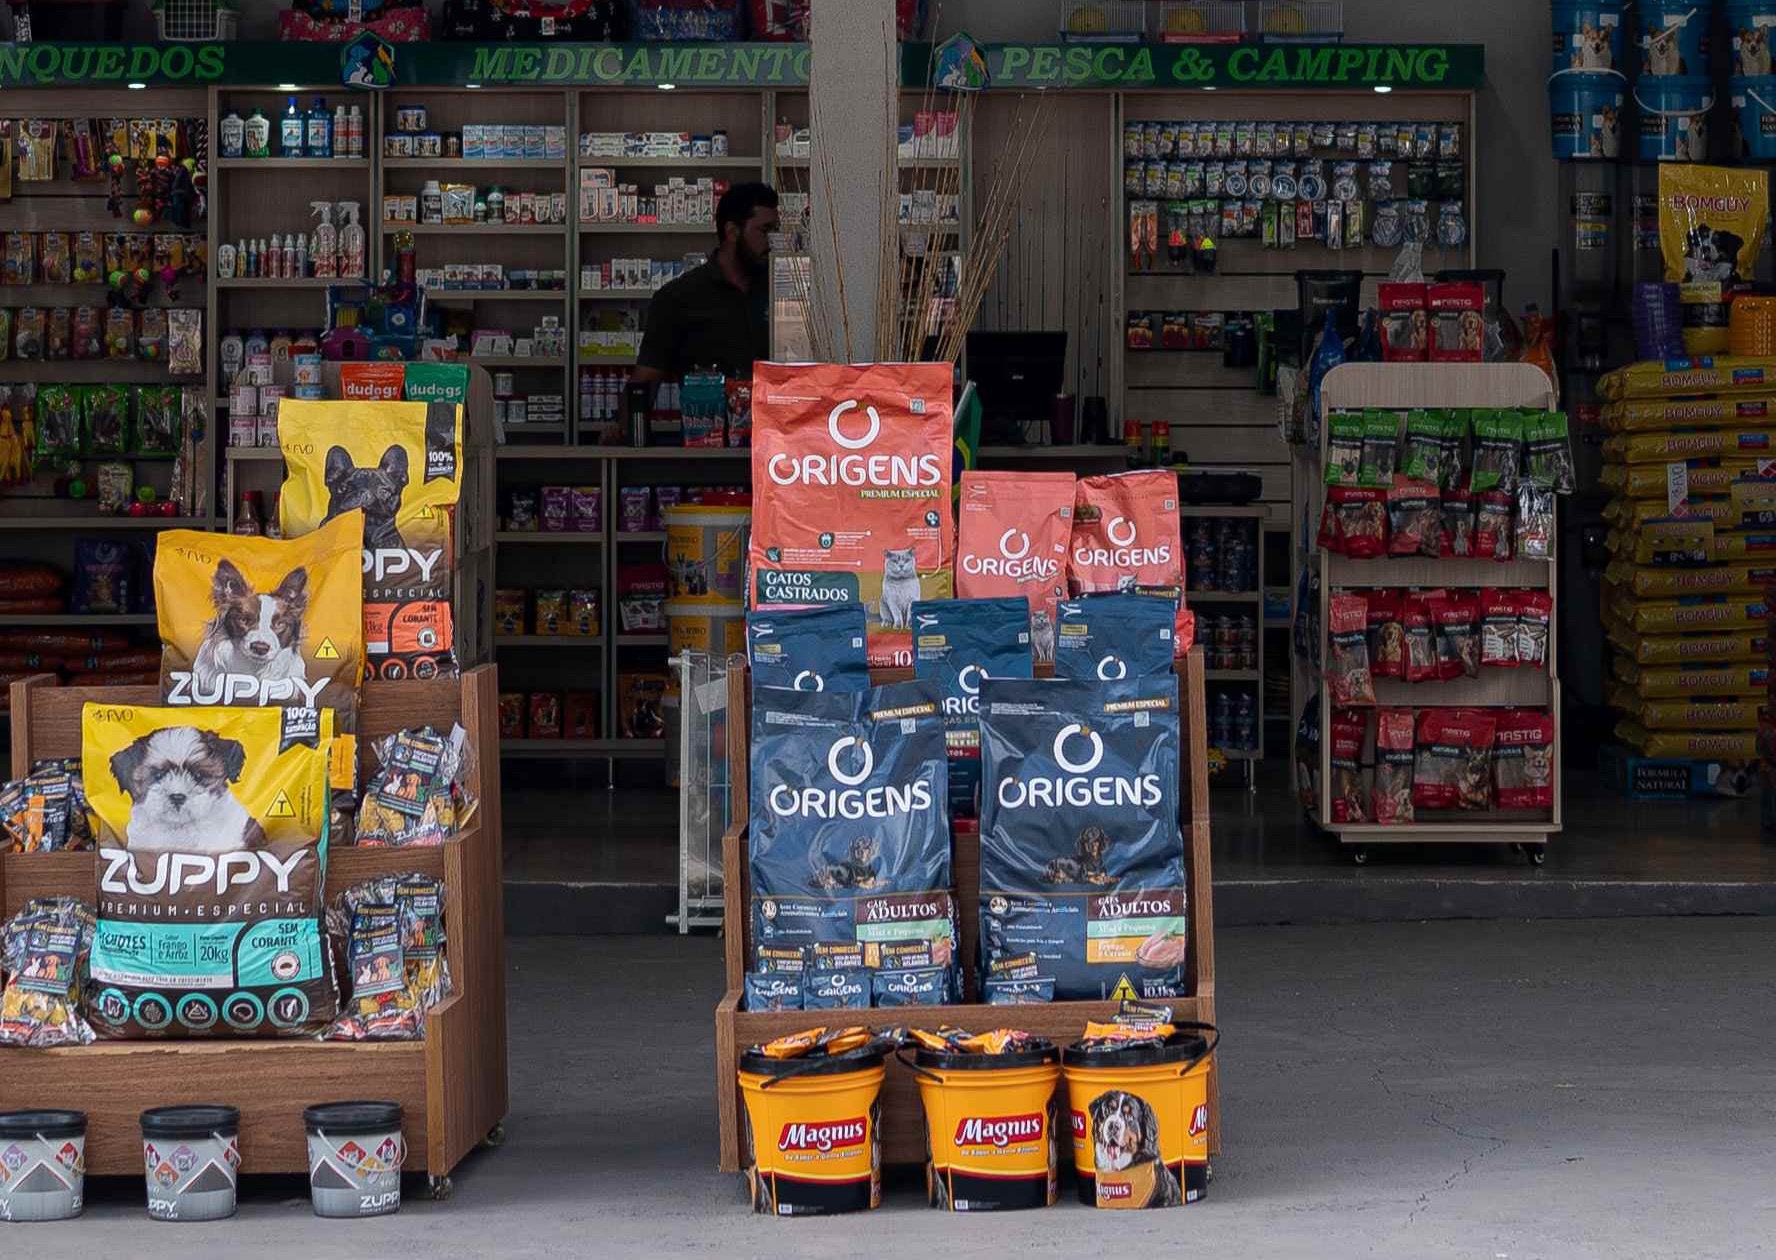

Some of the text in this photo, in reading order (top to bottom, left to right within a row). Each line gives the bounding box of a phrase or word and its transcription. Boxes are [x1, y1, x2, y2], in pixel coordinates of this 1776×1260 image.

[468, 46, 812, 84] MEDICAMENTO
[998, 46, 1451, 84] PESCA & CAMPING
[1673, 195, 1752, 212] BOMGUY
[346, 382, 398, 398] dudogs
[409, 382, 462, 398] dudogs
[428, 451, 454, 463] 100%
[768, 452, 942, 487] ORIGENS
[1075, 545, 1171, 567] ORIGENS
[963, 554, 1058, 578] ORIGENS
[766, 571, 812, 586] GATOS
[362, 588, 443, 598] SPECIAL
[765, 587, 849, 601] CASTRADOS
[167, 670, 332, 709] ZUPPY
[285, 706, 318, 719] 100%
[769, 780, 932, 820] ORIGENS
[998, 774, 1163, 809] ORIGENS
[99, 848, 309, 896] ZUPPY
[101, 900, 306, 917] PREMIUM ESPECIAL
[867, 902, 937, 920] ADULTOS
[1099, 900, 1171, 918] ADULTOS
[278, 922, 299, 934] SEM
[251, 936, 299, 949] CORANTE
[200, 945, 229, 963] 20kg
[817, 984, 863, 996] ORIGENS
[887, 982, 933, 993] ORIGENS
[778, 1121, 864, 1152] Magnus
[954, 1117, 1042, 1146] Magnus
